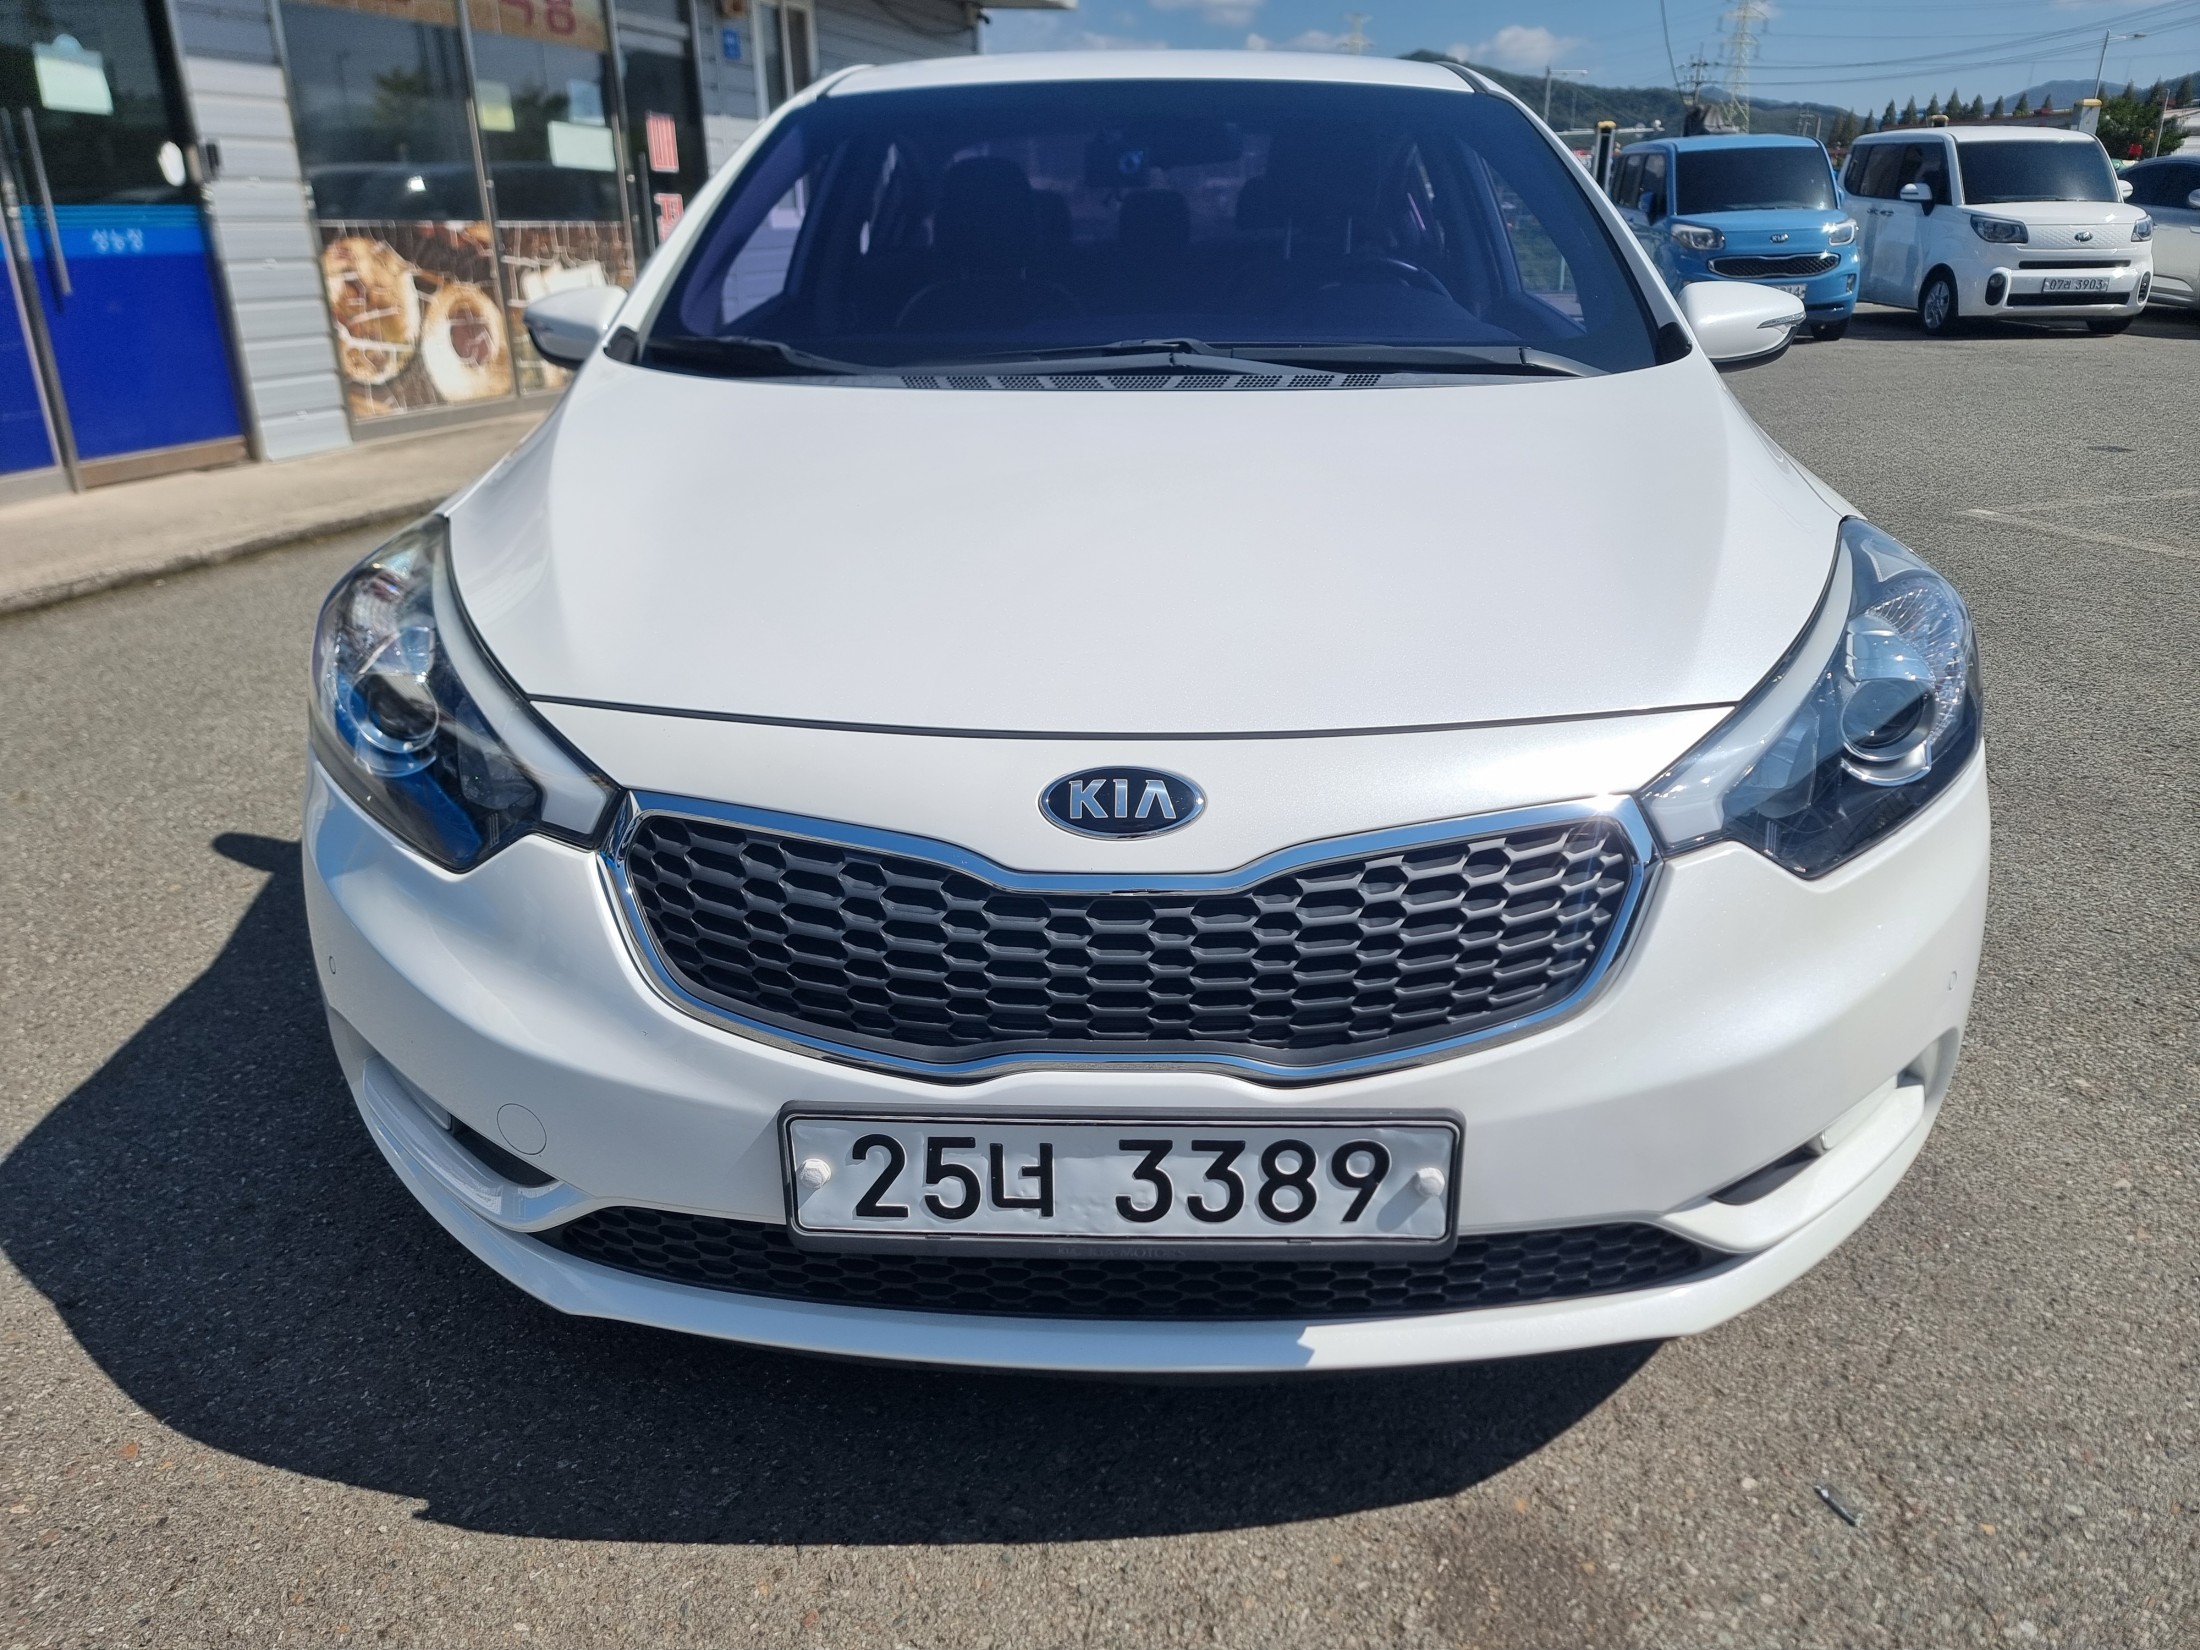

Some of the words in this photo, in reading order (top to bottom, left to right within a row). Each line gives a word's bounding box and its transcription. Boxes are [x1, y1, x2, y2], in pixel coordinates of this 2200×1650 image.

[2075, 279, 2103, 290] 3903
[1069, 778, 1176, 820] KIA
[851, 1133, 1054, 1219] 25너
[1115, 1138, 1391, 1223] 3389
[1119, 1247, 1187, 1258] MOTORS
